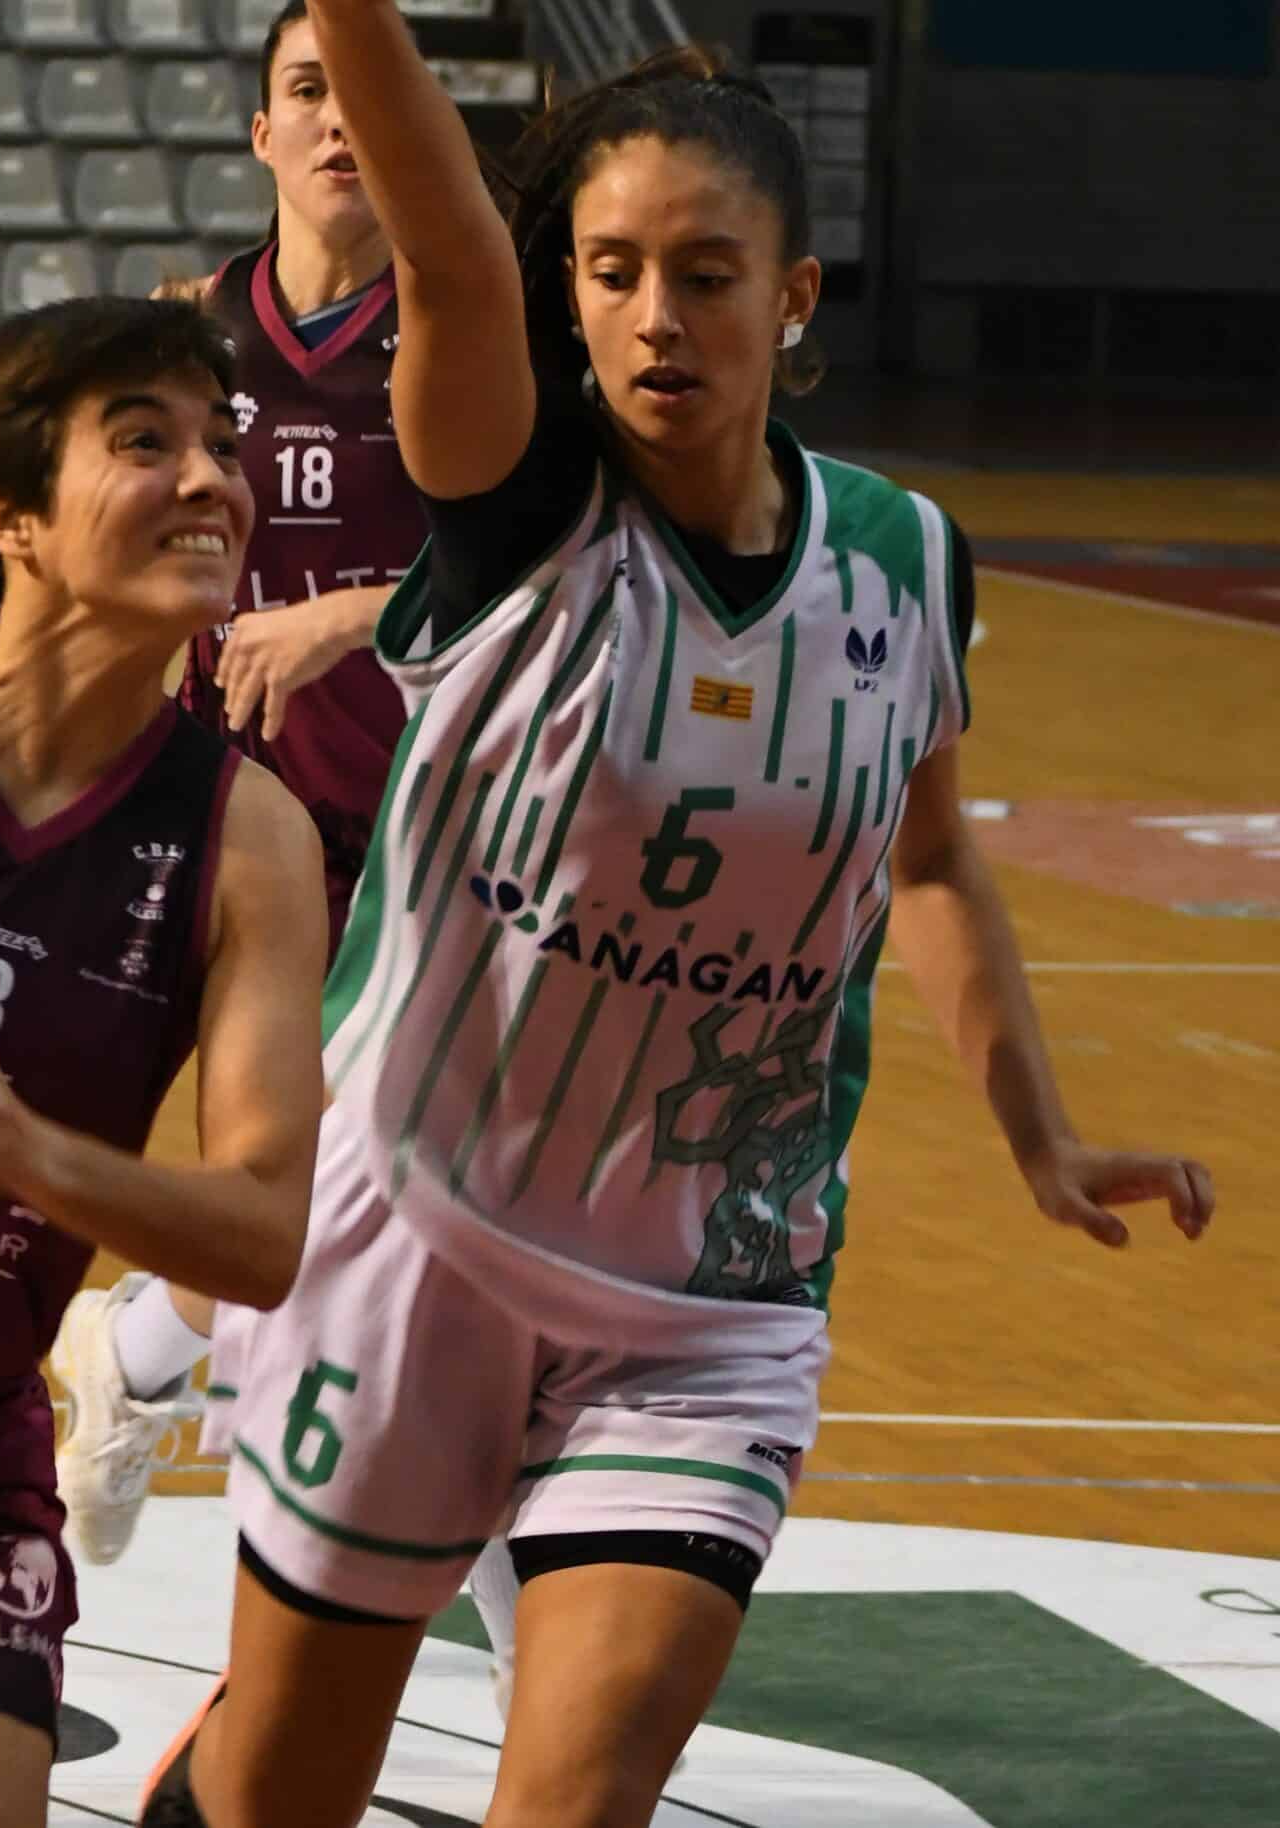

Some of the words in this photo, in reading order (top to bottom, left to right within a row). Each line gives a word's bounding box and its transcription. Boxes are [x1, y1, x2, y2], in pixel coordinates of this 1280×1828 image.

[275, 445, 333, 509] 18
[639, 786, 735, 909] 6
[539, 920, 826, 1003] ANAGAN
[282, 1360, 358, 1488] 6
